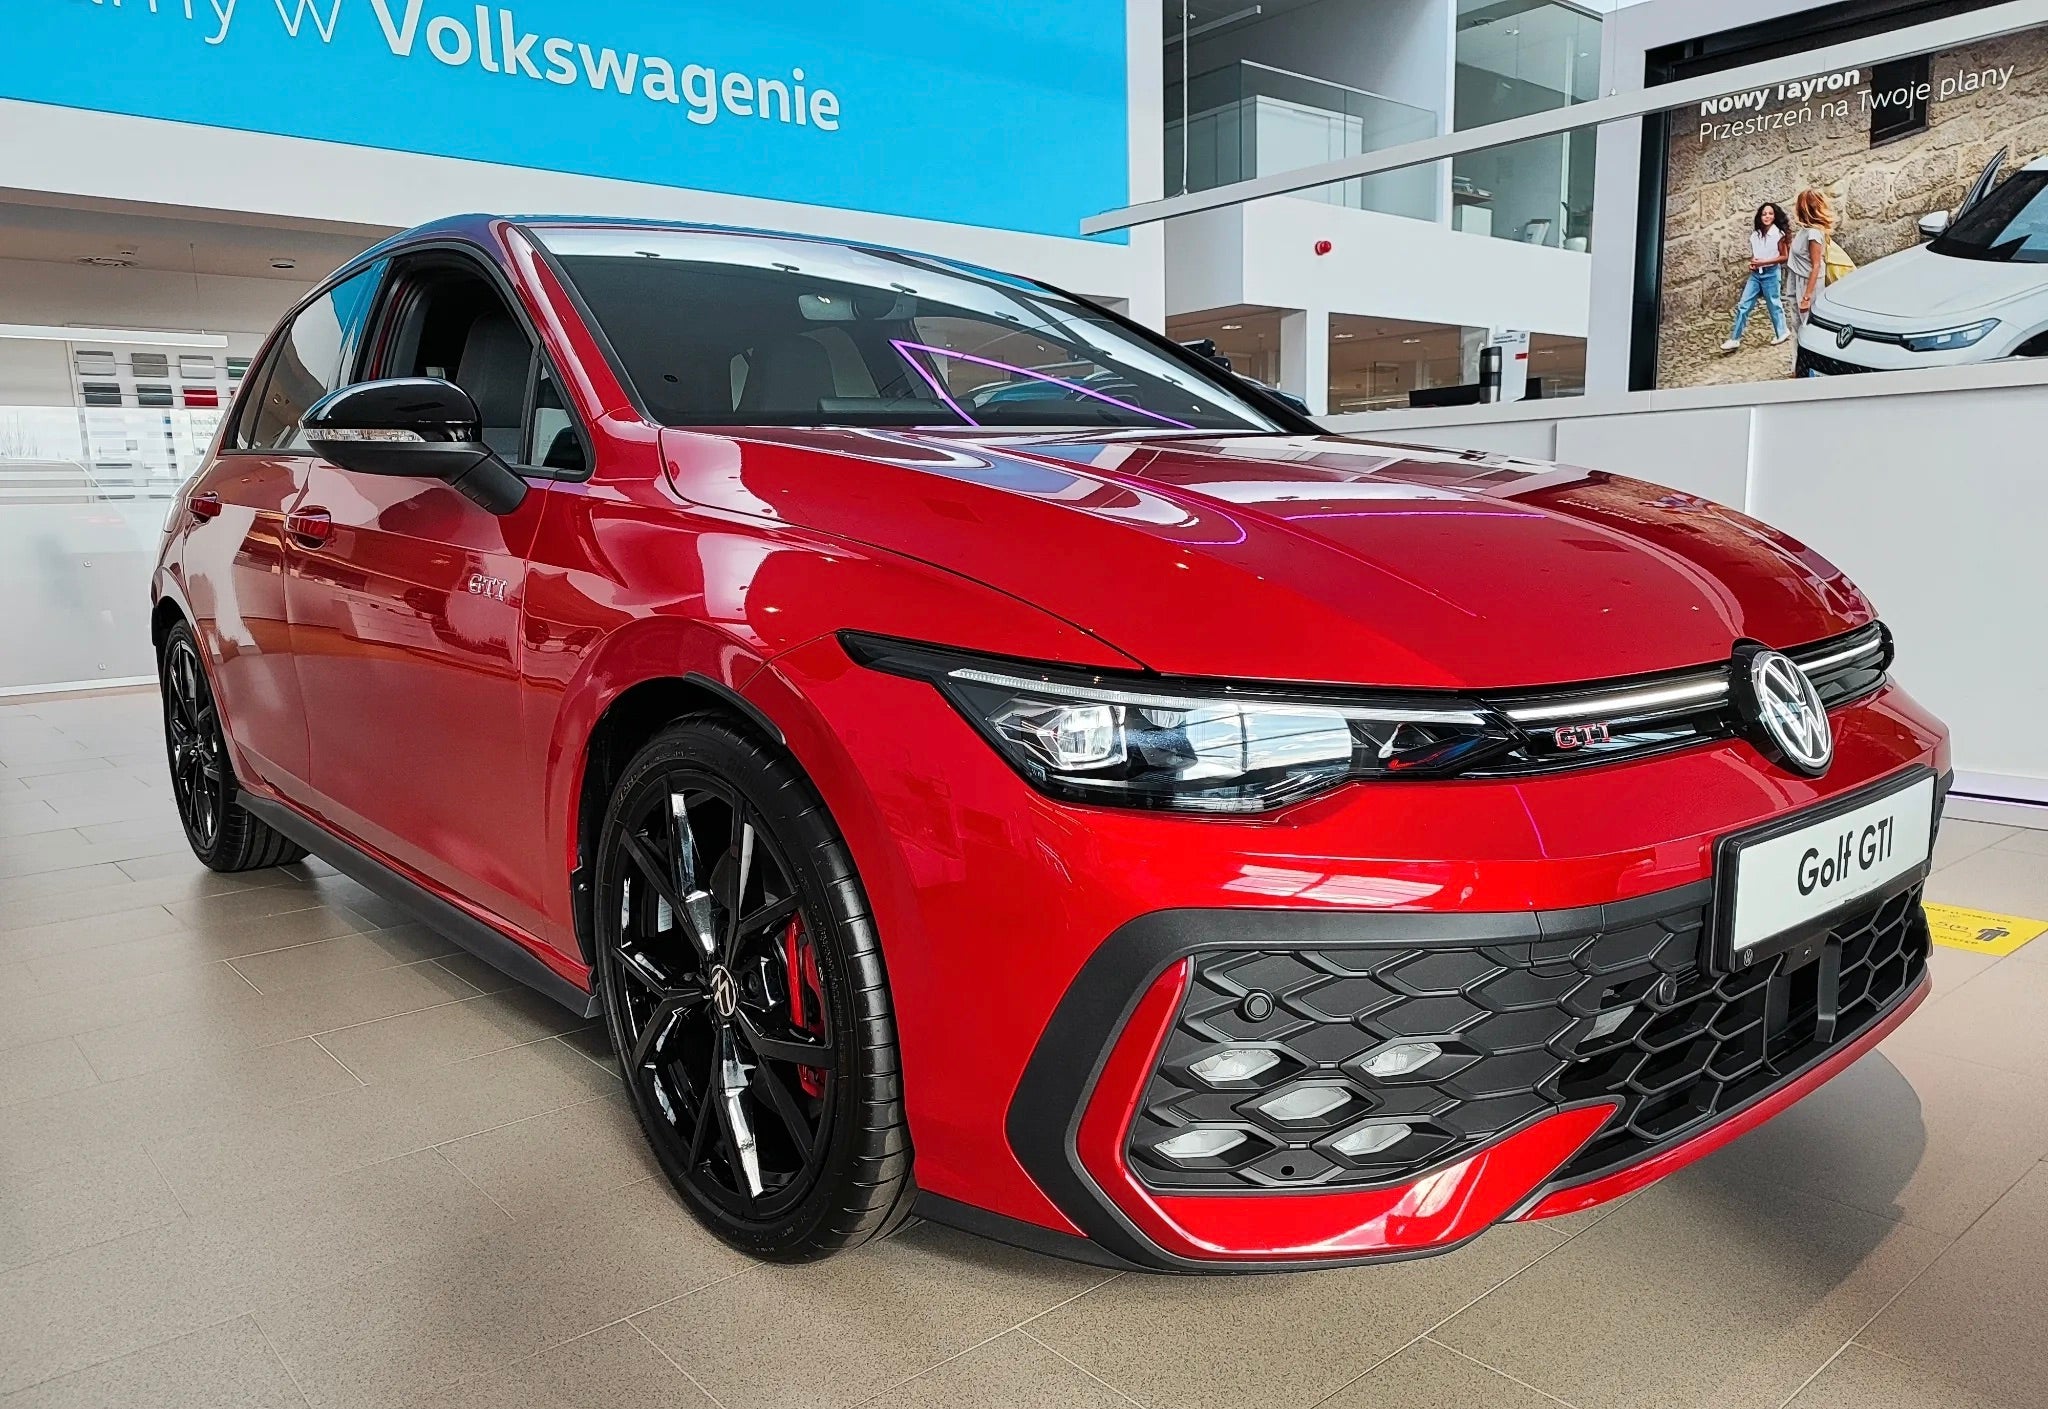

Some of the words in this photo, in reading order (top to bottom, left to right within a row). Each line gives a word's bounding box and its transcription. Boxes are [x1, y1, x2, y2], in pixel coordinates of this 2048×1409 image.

[371, 0, 841, 131] Volkswagenie
[1700, 88, 1770, 117] Nowy
[1700, 102, 1811, 143] Przestrzeń
[1820, 99, 1849, 119] na
[1857, 80, 1931, 112] Twoje
[1938, 65, 2015, 102] plany
[468, 573, 507, 602] GTI
[1555, 721, 1611, 749] GTI
[1797, 830, 1853, 896] Golf
[1858, 815, 1893, 870] GTI
